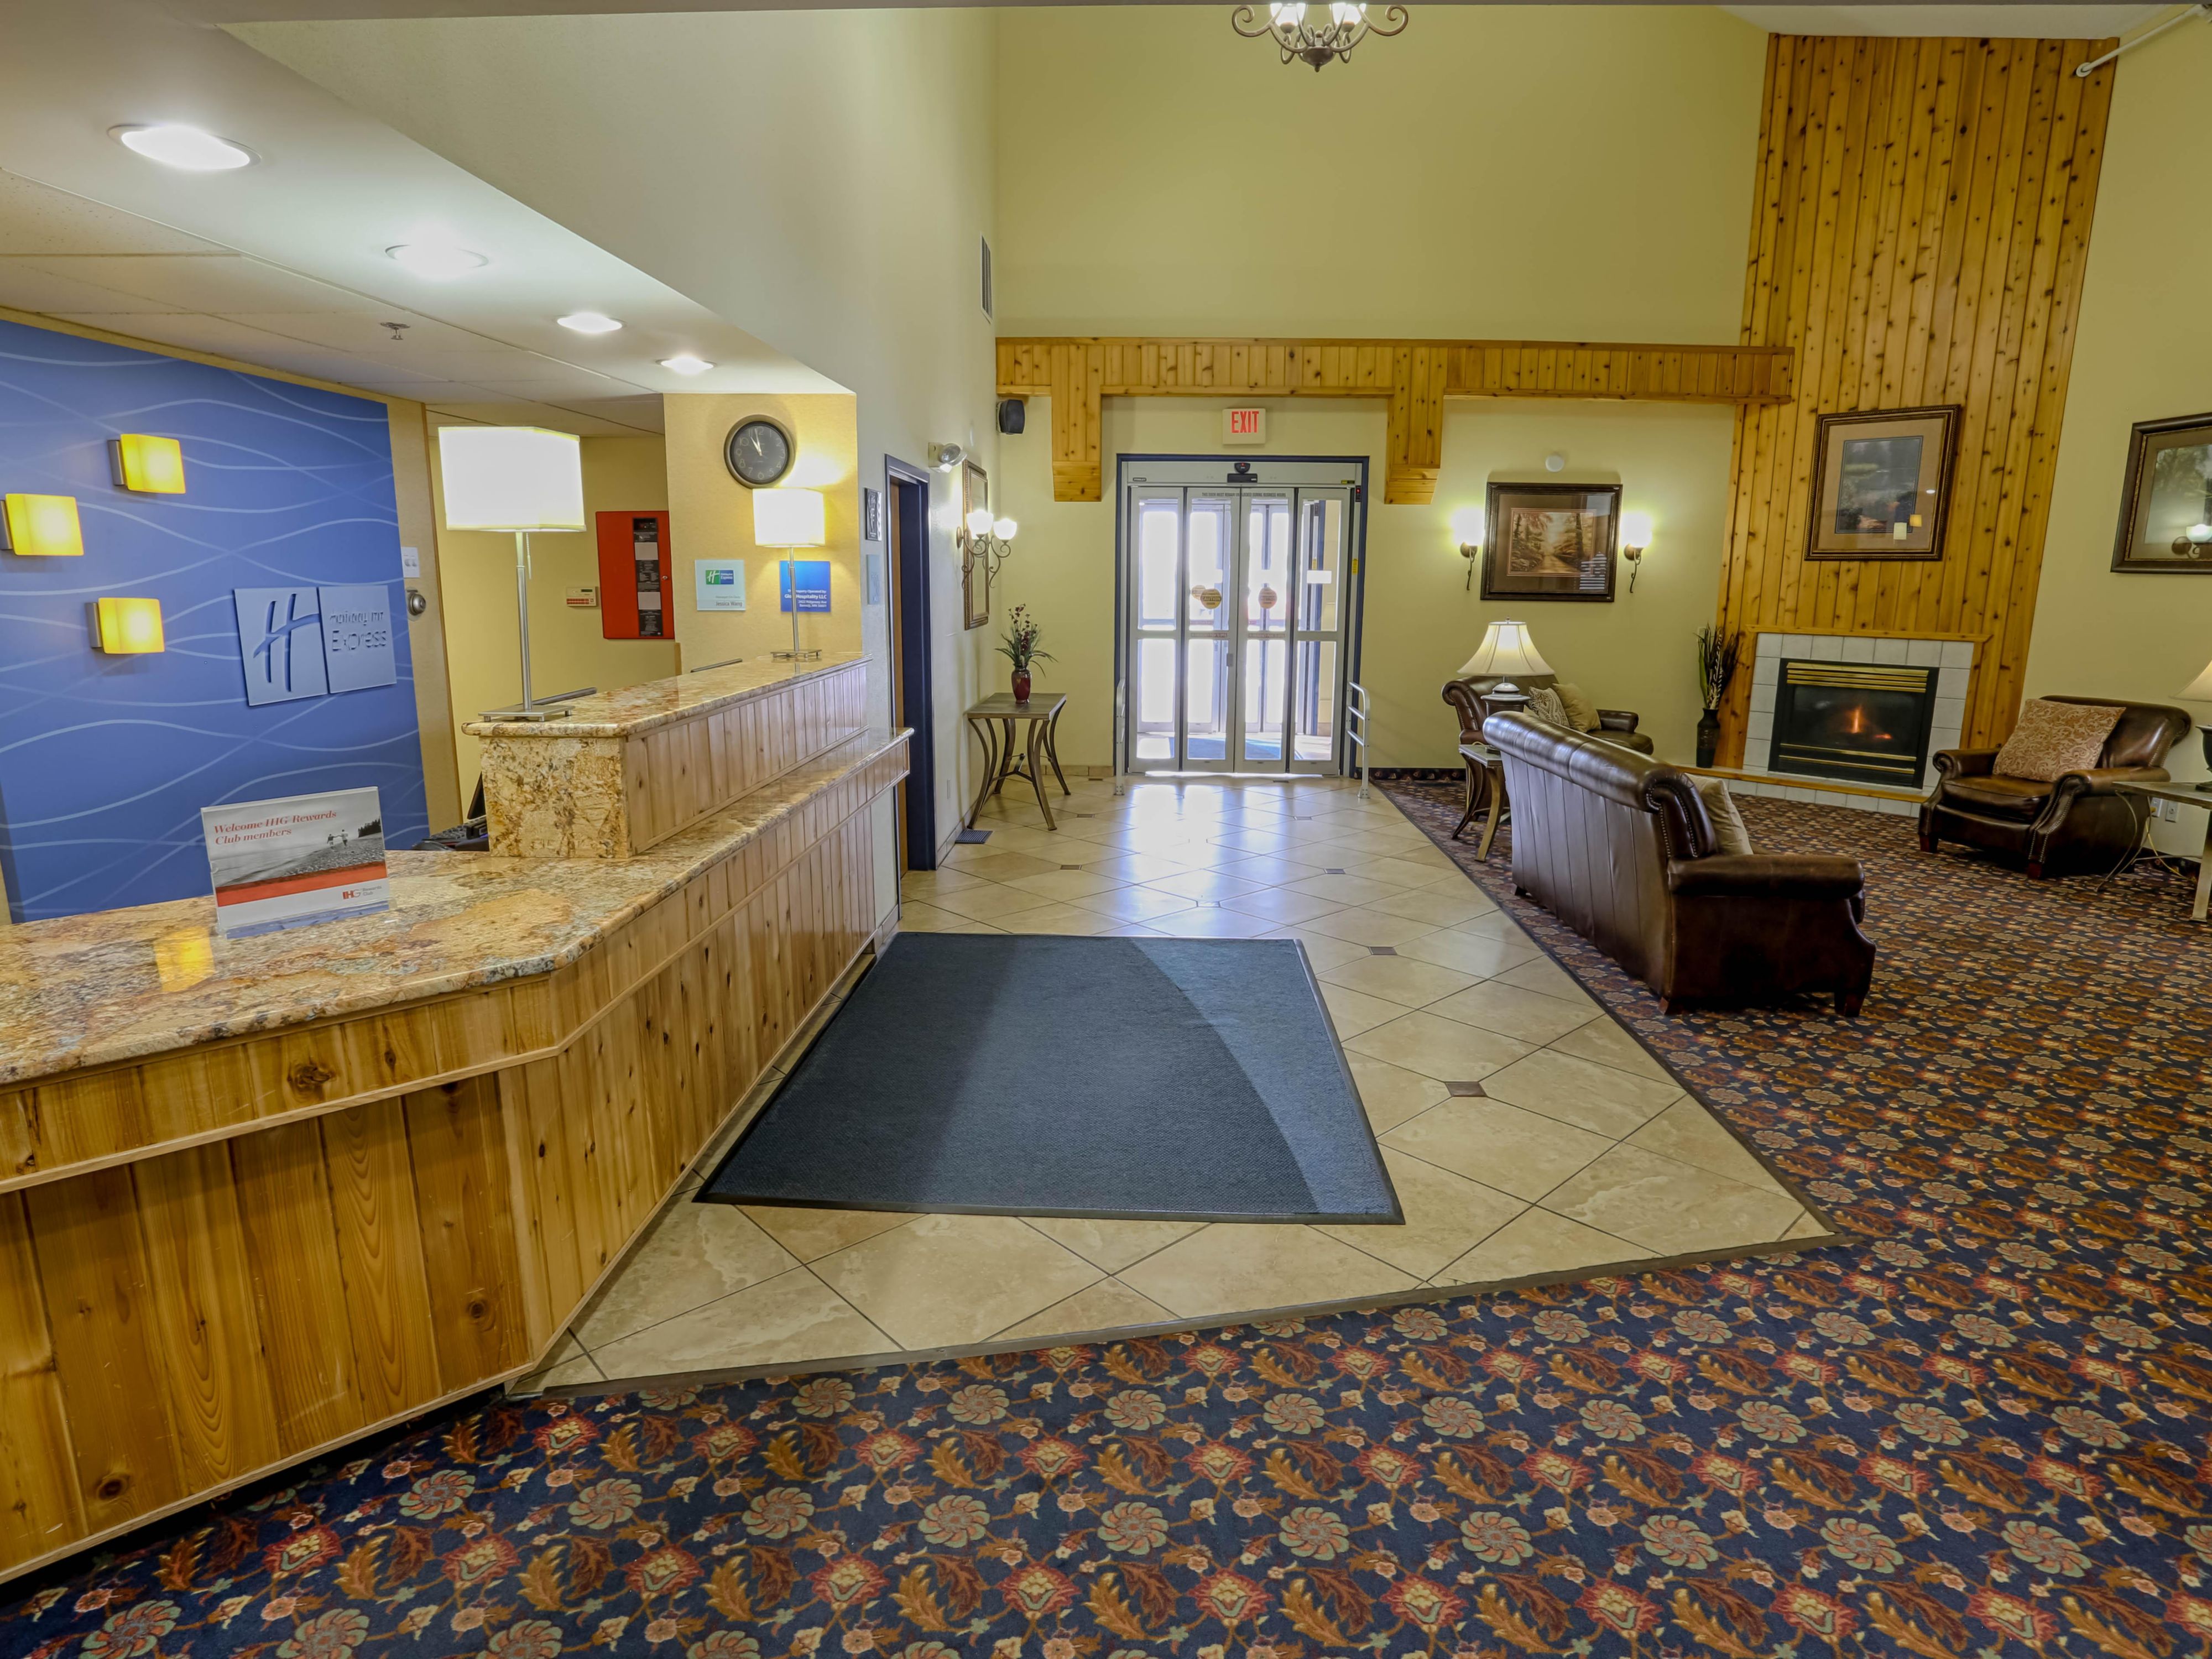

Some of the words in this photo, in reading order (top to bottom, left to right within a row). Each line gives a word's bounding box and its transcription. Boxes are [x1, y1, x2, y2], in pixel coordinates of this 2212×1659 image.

[1232, 411, 1259, 433] EXIT
[739, 437, 749, 446] 10
[775, 437, 782, 447] 2
[735, 448, 742, 456] 9
[779, 448, 785, 459] 3
[739, 458, 746, 468] 8
[776, 461, 781, 469] 4
[748, 467, 753, 476] 7
[758, 471, 764, 479] 6
[769, 468, 775, 477] 5
[332, 630, 387, 651] Express
[214, 822, 263, 834] Welcome
[265, 817, 289, 827] IHG
[292, 810, 337, 823] Rewards
[215, 833, 241, 845] Club
[243, 829, 291, 841] members
[342, 889, 361, 899] IHG
